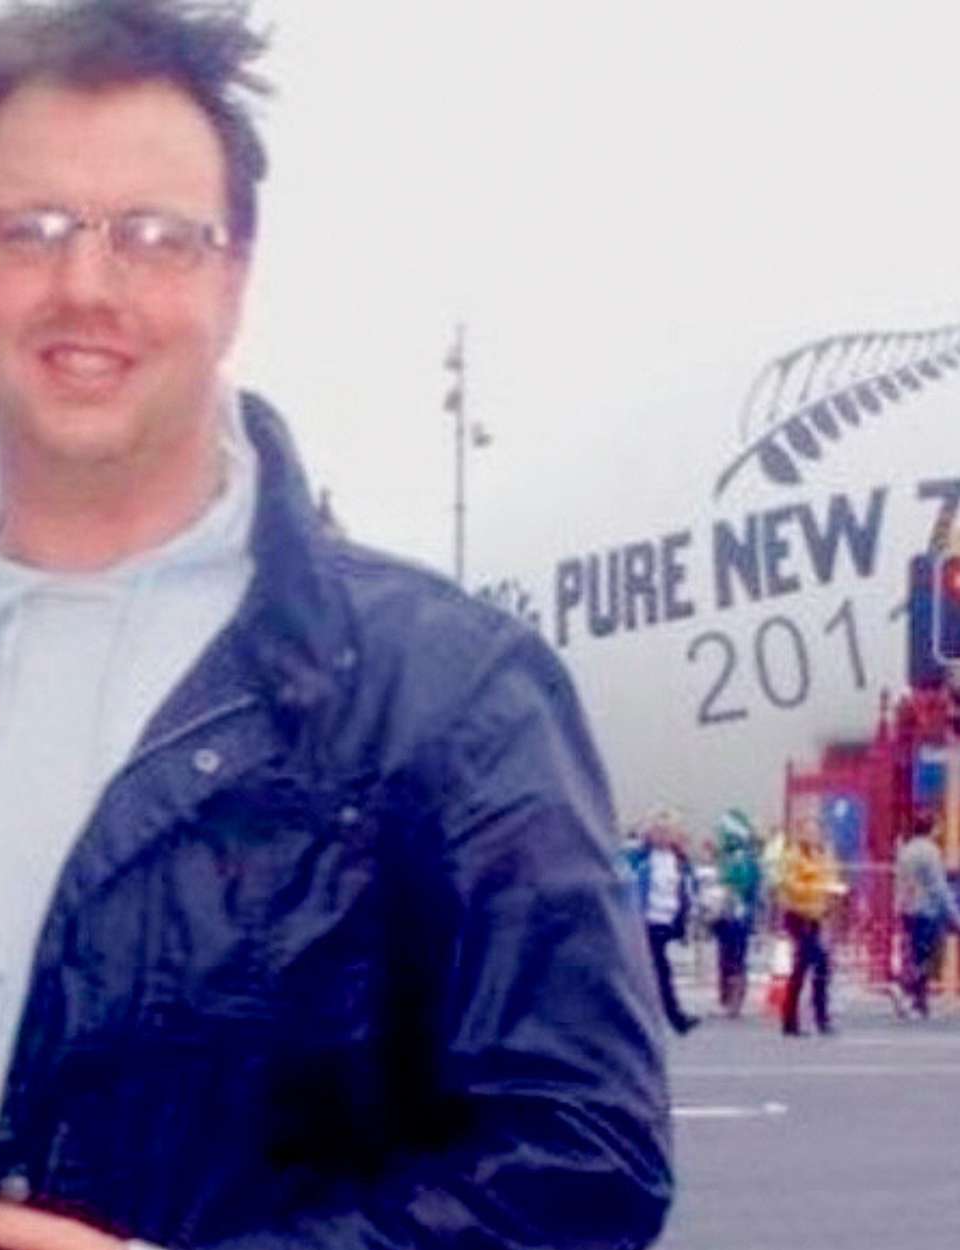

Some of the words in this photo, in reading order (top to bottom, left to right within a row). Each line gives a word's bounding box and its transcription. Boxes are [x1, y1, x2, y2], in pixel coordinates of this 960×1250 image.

[556, 530, 696, 648] PURE
[712, 486, 888, 610] NEW
[687, 599, 910, 727] 201
